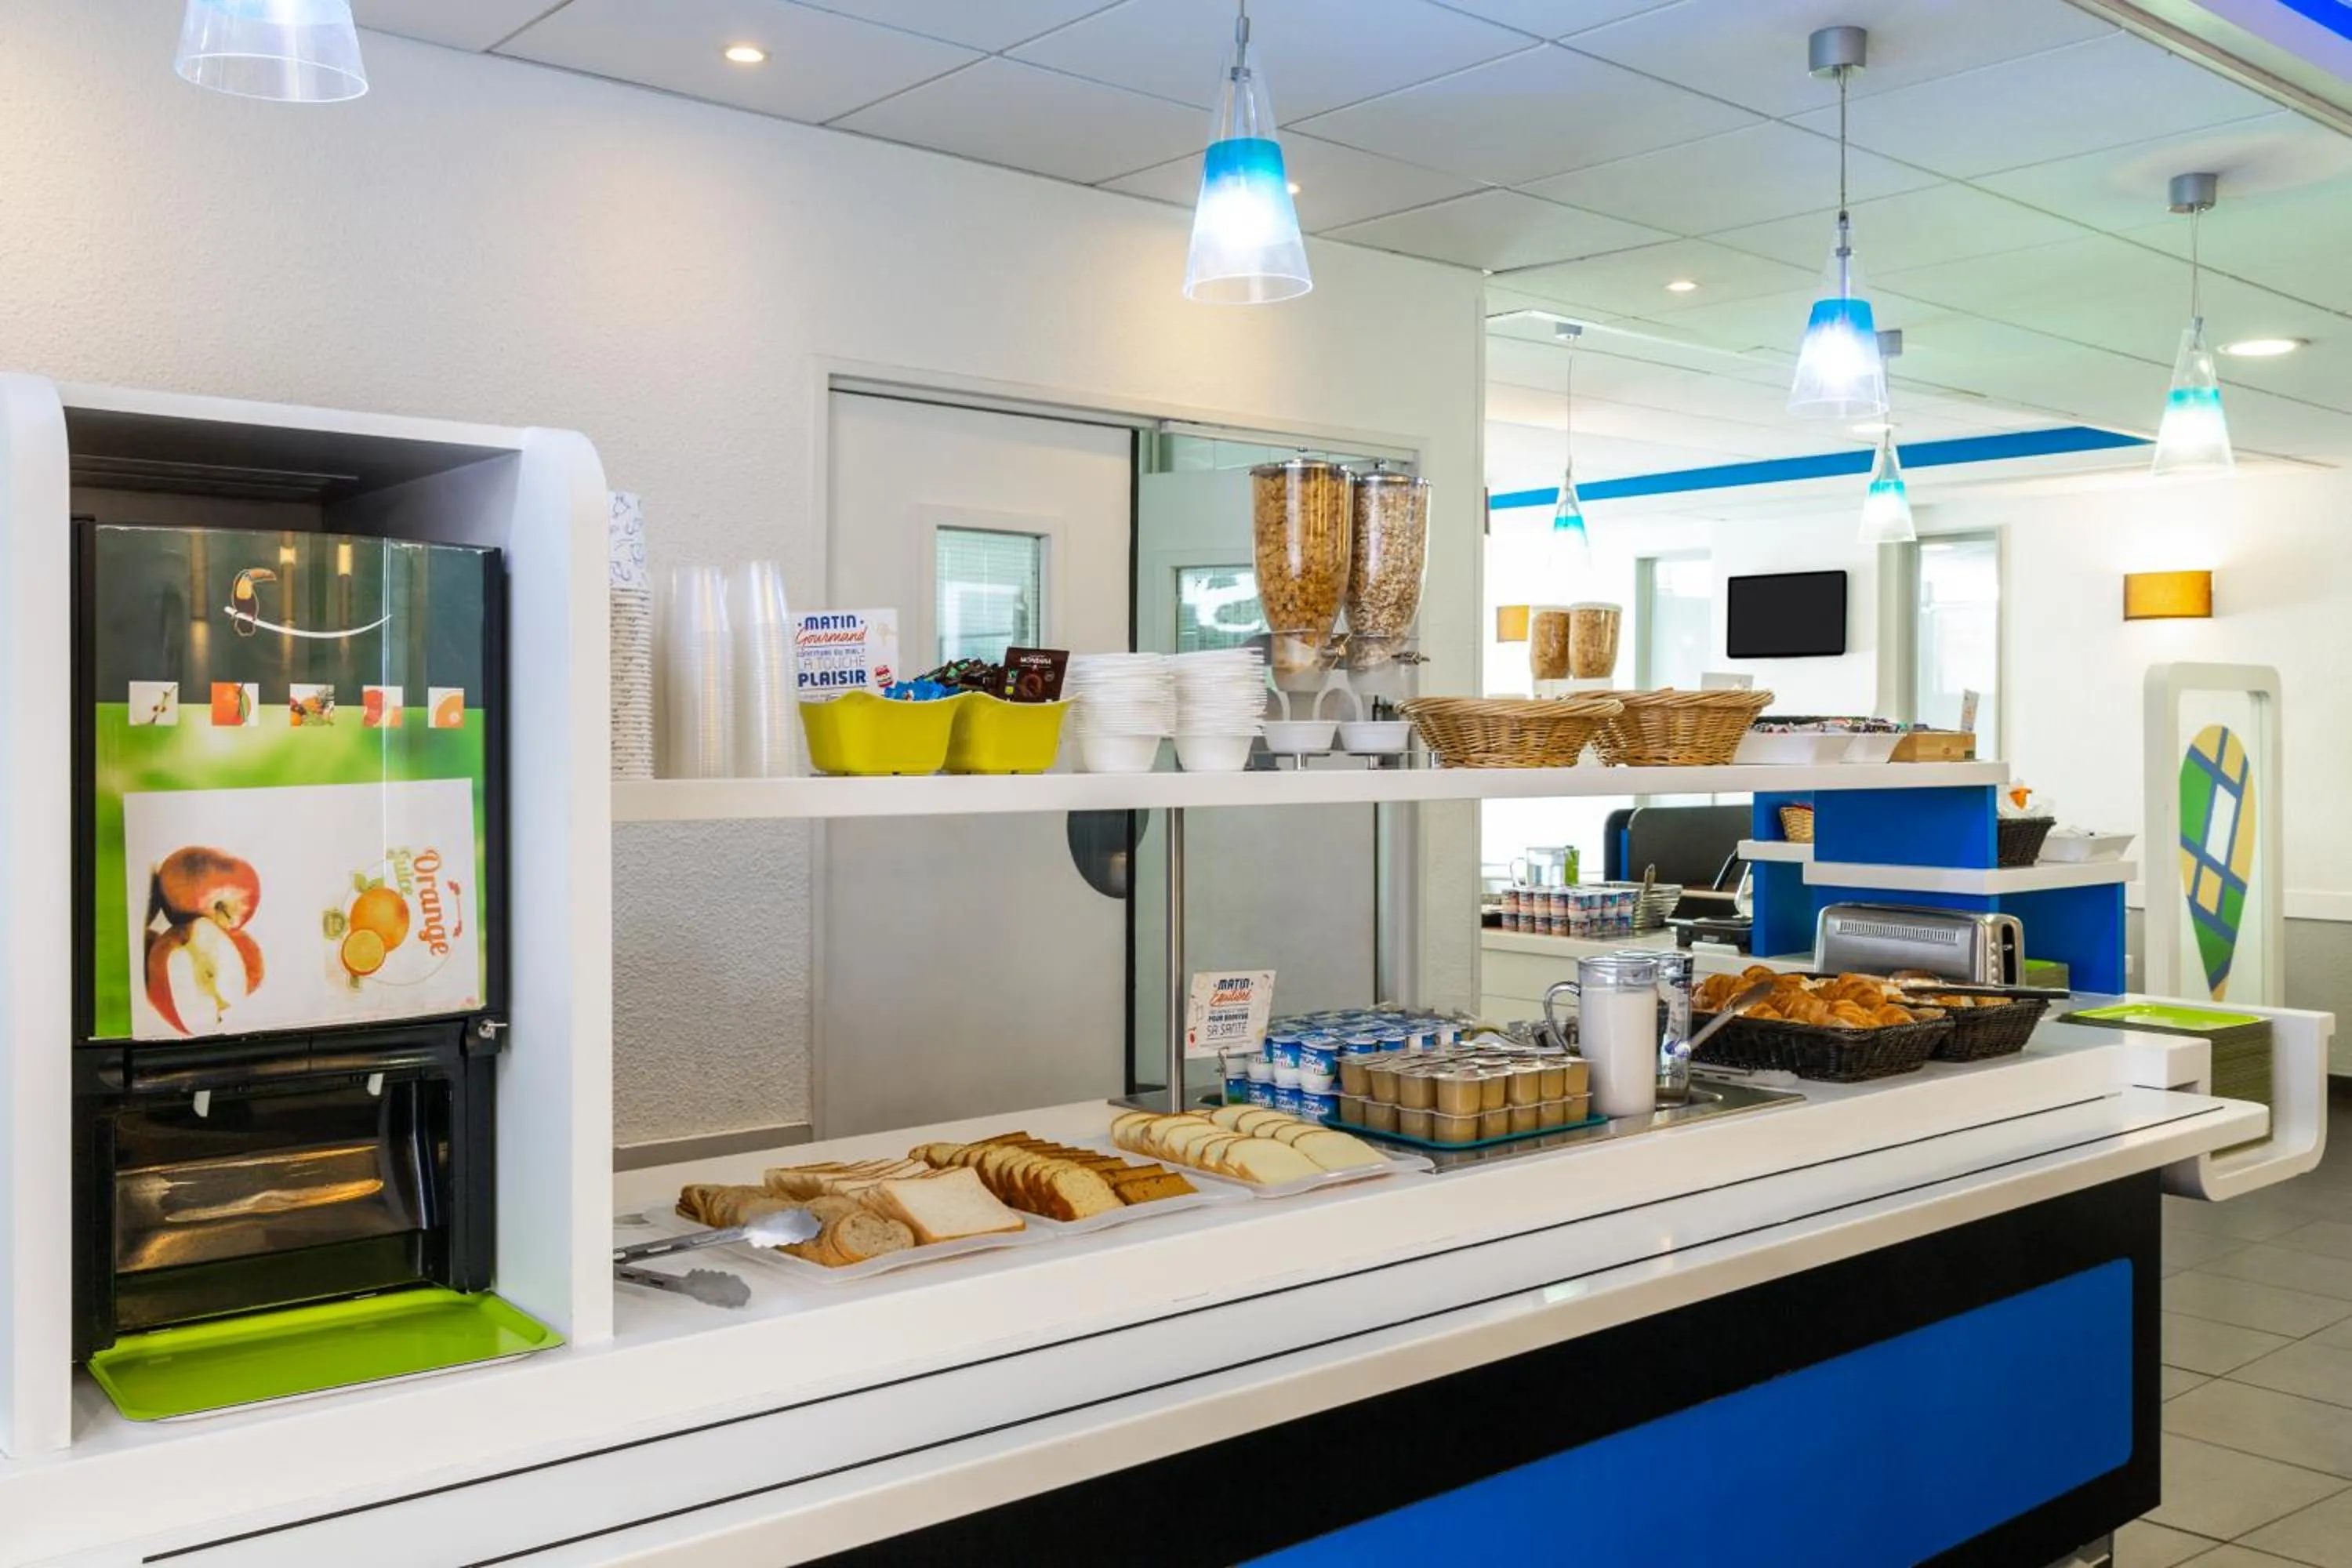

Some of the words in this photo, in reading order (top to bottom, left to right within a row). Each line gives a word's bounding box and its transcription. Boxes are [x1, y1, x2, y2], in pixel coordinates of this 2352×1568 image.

[805, 615, 857, 630] MATIN
[795, 625, 869, 647] Gourmand
[797, 669, 866, 688] PLAISIR
[414, 848, 449, 956] Orange
